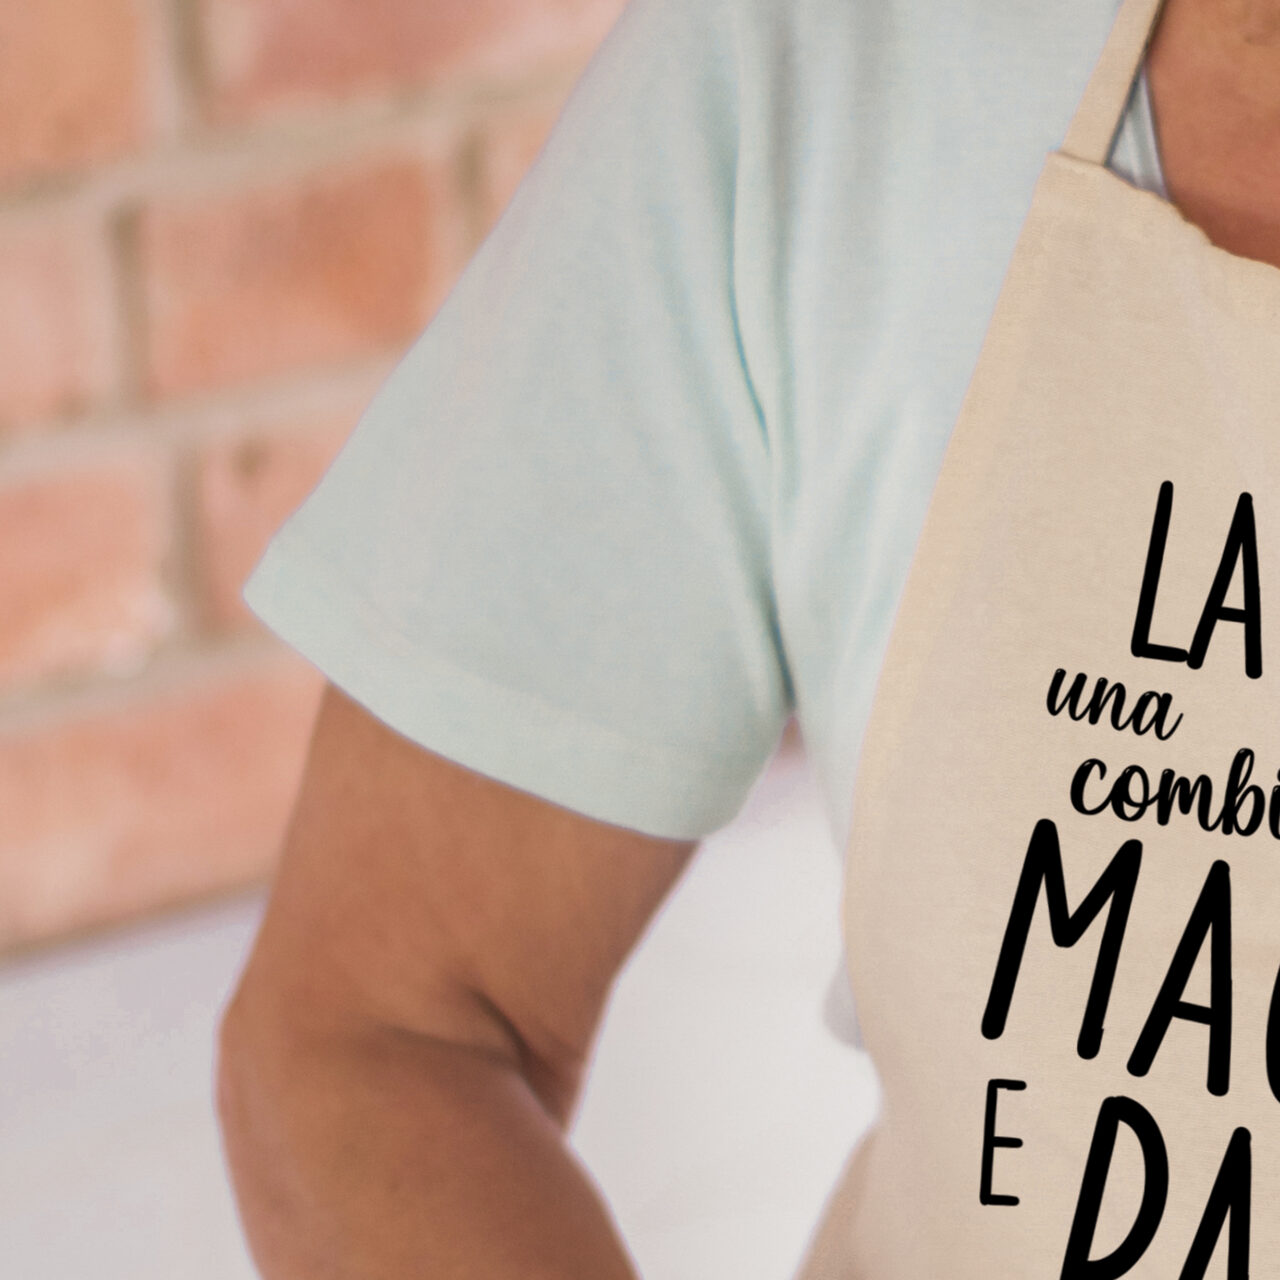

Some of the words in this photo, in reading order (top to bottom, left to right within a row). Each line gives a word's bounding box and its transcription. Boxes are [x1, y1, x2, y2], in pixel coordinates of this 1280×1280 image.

[1129, 479, 1264, 681] LA
[1045, 667, 1185, 742] una
[978, 1077, 1028, 1207] E
